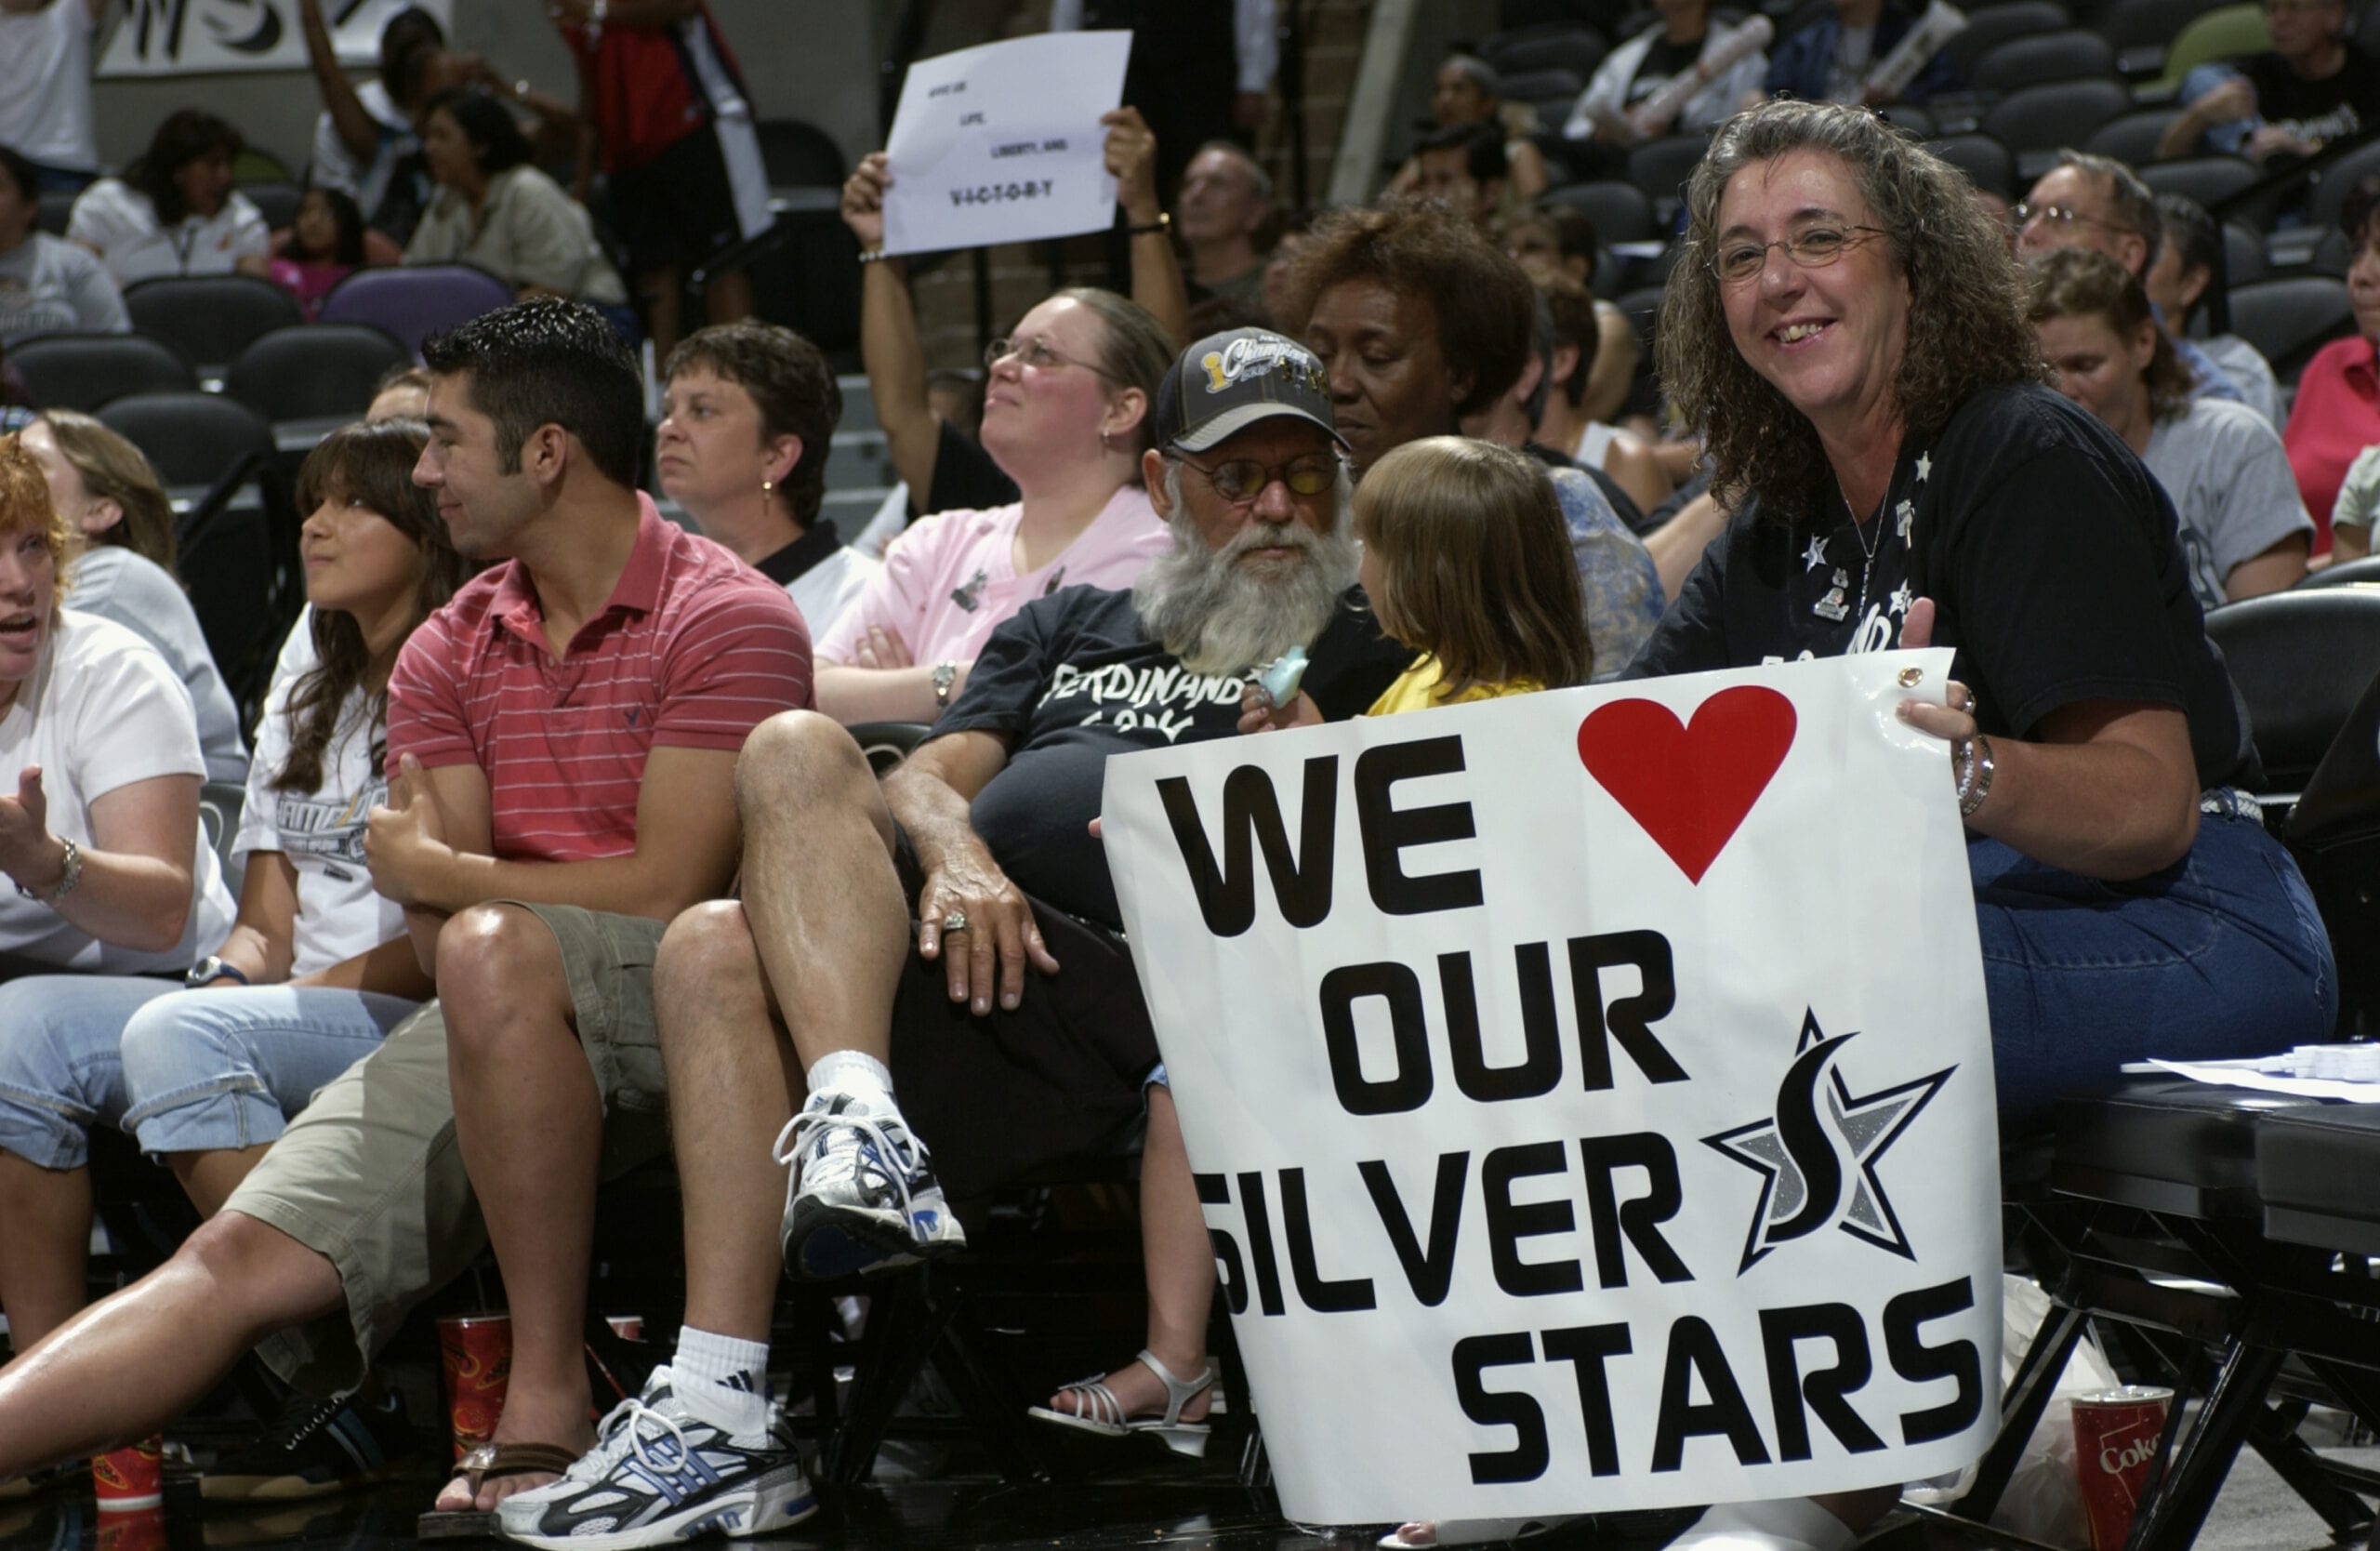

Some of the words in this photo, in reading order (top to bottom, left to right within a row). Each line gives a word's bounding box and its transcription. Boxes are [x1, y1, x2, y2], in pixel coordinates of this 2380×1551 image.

[1155, 735, 1484, 937] WE
[1318, 929, 1691, 1116] OUR
[1192, 1131, 1696, 1317] SILVER
[1451, 1276, 1983, 1485] STARS
